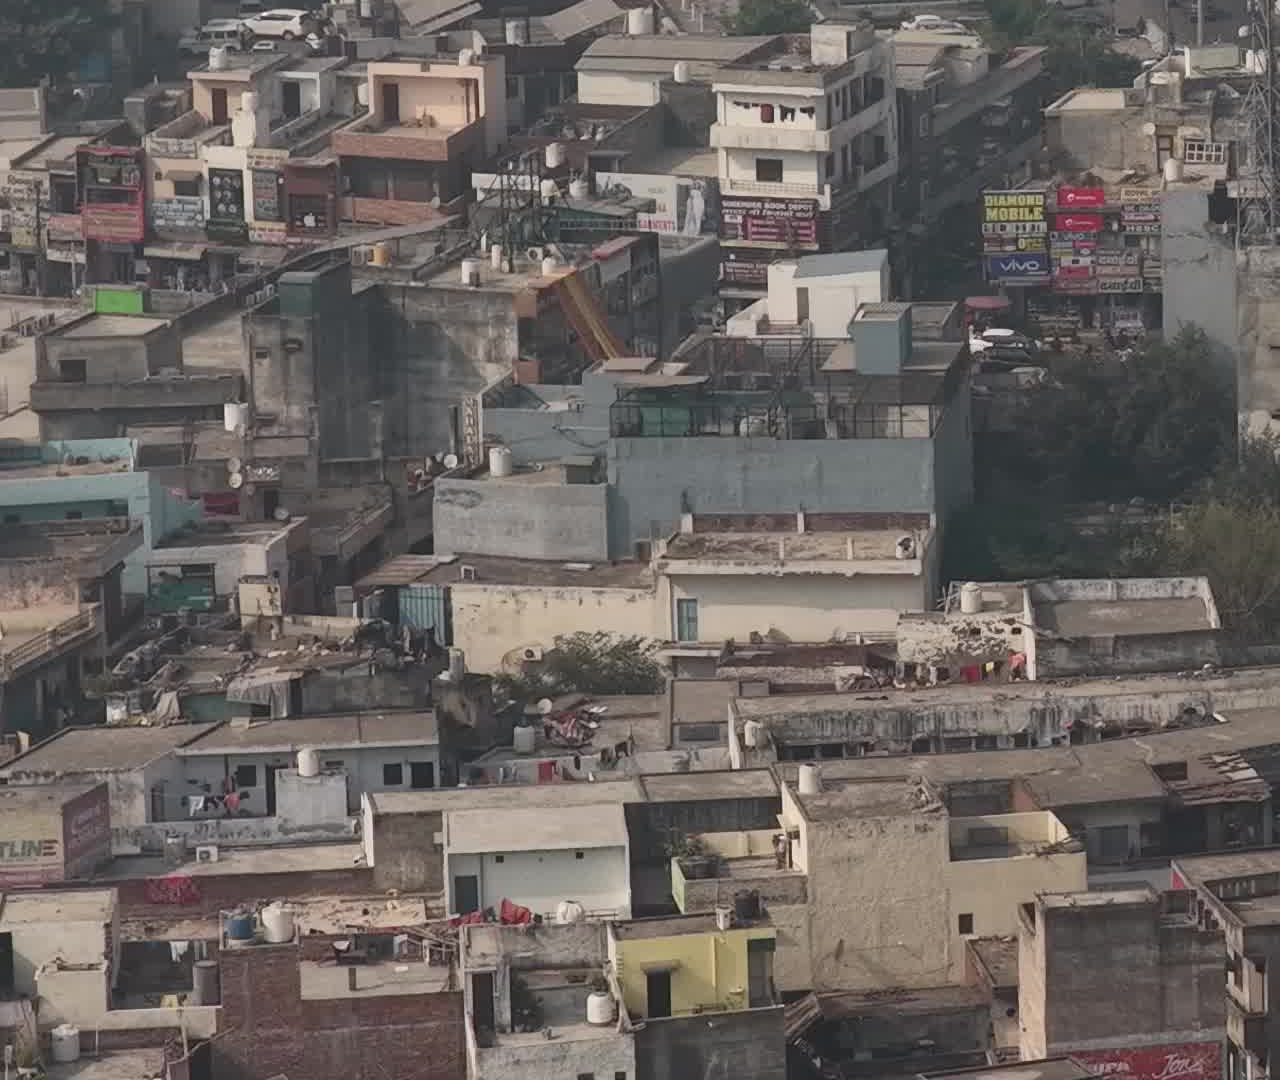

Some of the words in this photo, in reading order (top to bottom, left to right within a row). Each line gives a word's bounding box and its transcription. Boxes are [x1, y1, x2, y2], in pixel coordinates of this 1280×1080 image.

[984, 194, 1044, 207] DIAMOND
[986, 207, 1043, 221] MOBILE
[1000, 259, 1040, 271] vivo
